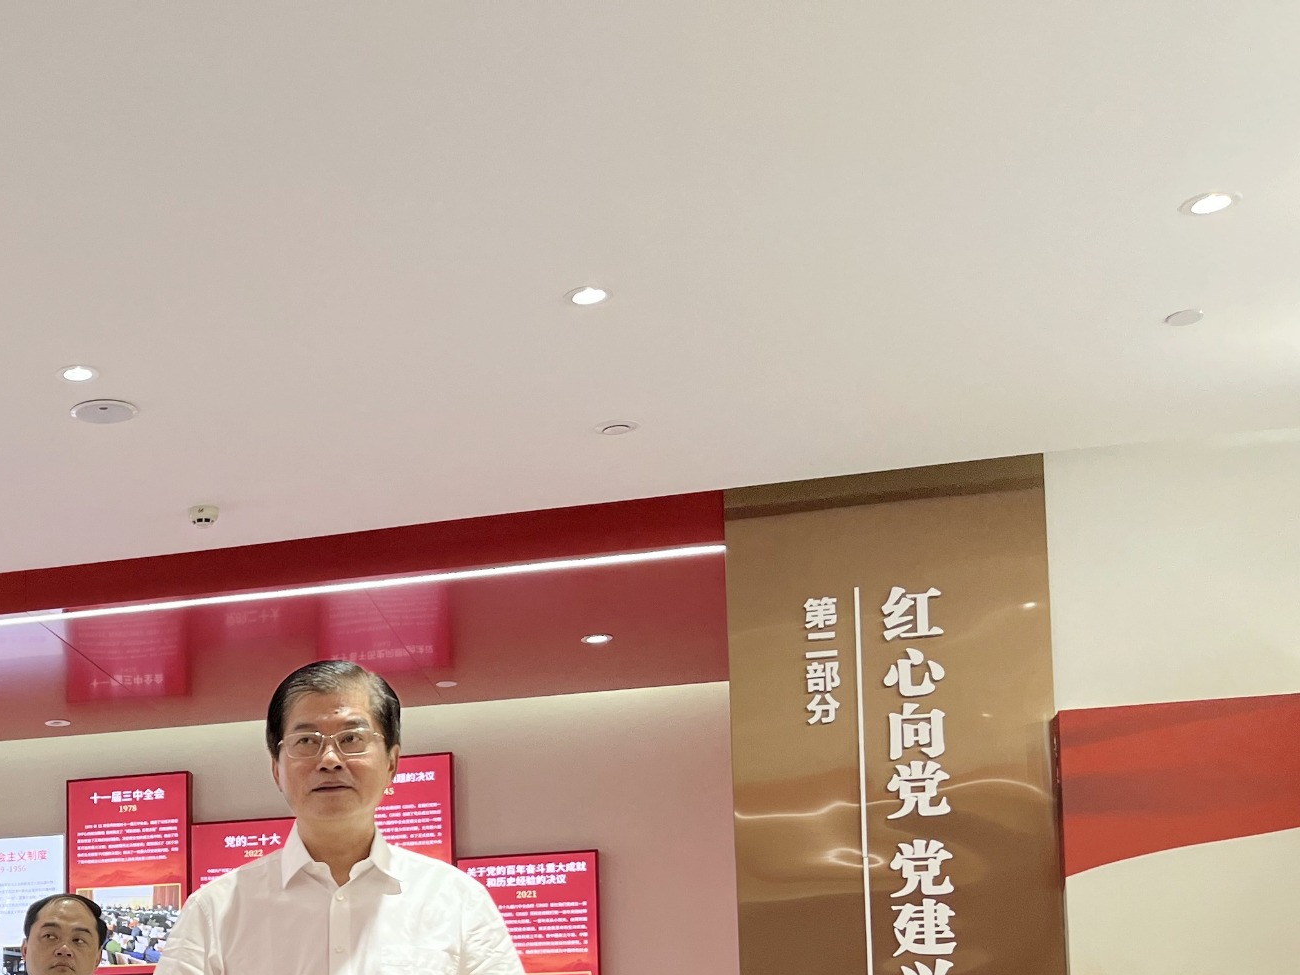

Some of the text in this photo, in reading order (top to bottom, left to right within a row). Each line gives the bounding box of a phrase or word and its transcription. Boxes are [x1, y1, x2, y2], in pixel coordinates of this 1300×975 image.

[803, 597, 840, 725] 第二部分
[881, 586, 951, 820] 红心向党
[393, 771, 436, 783] 题的决议
[90, 788, 165, 804] 十一届三中全会
[119, 805, 137, 813] 1978
[224, 833, 281, 848] 党的二十大
[244, 849, 264, 857] 2022
[516, 890, 537, 899] 2021
